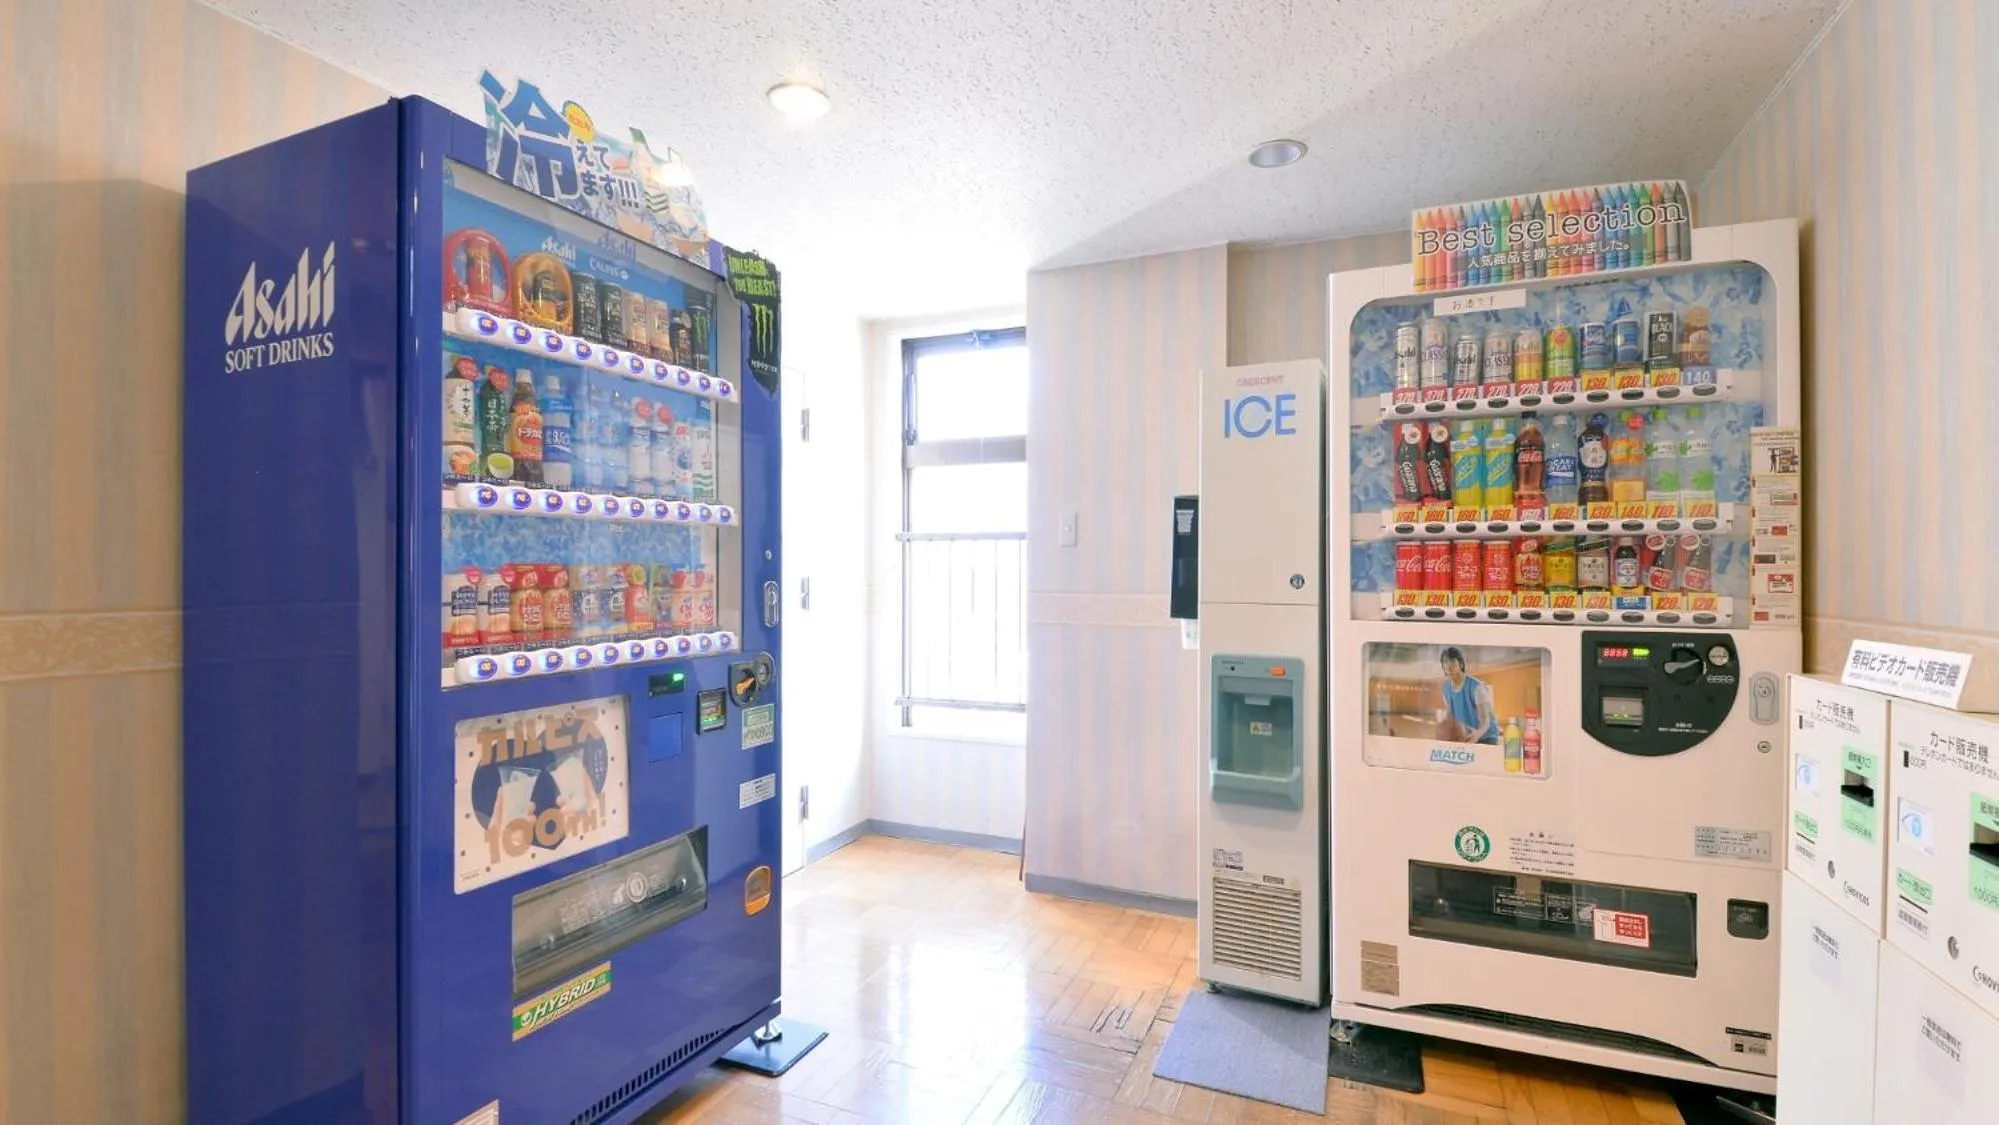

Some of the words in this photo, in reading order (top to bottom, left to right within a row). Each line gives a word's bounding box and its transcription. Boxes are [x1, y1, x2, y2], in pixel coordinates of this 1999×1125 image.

[479, 68, 579, 199] 冷
[1417, 223, 1497, 257] Best
[1507, 200, 1687, 245] selection
[225, 240, 335, 346] Asahi
[225, 344, 265, 374] SOFT
[268, 332, 334, 366] DRINKS
[1224, 394, 1297, 439] ICE
[1929, 731, 1989, 764] カード販売機
[532, 976, 597, 1025] HYBRID
